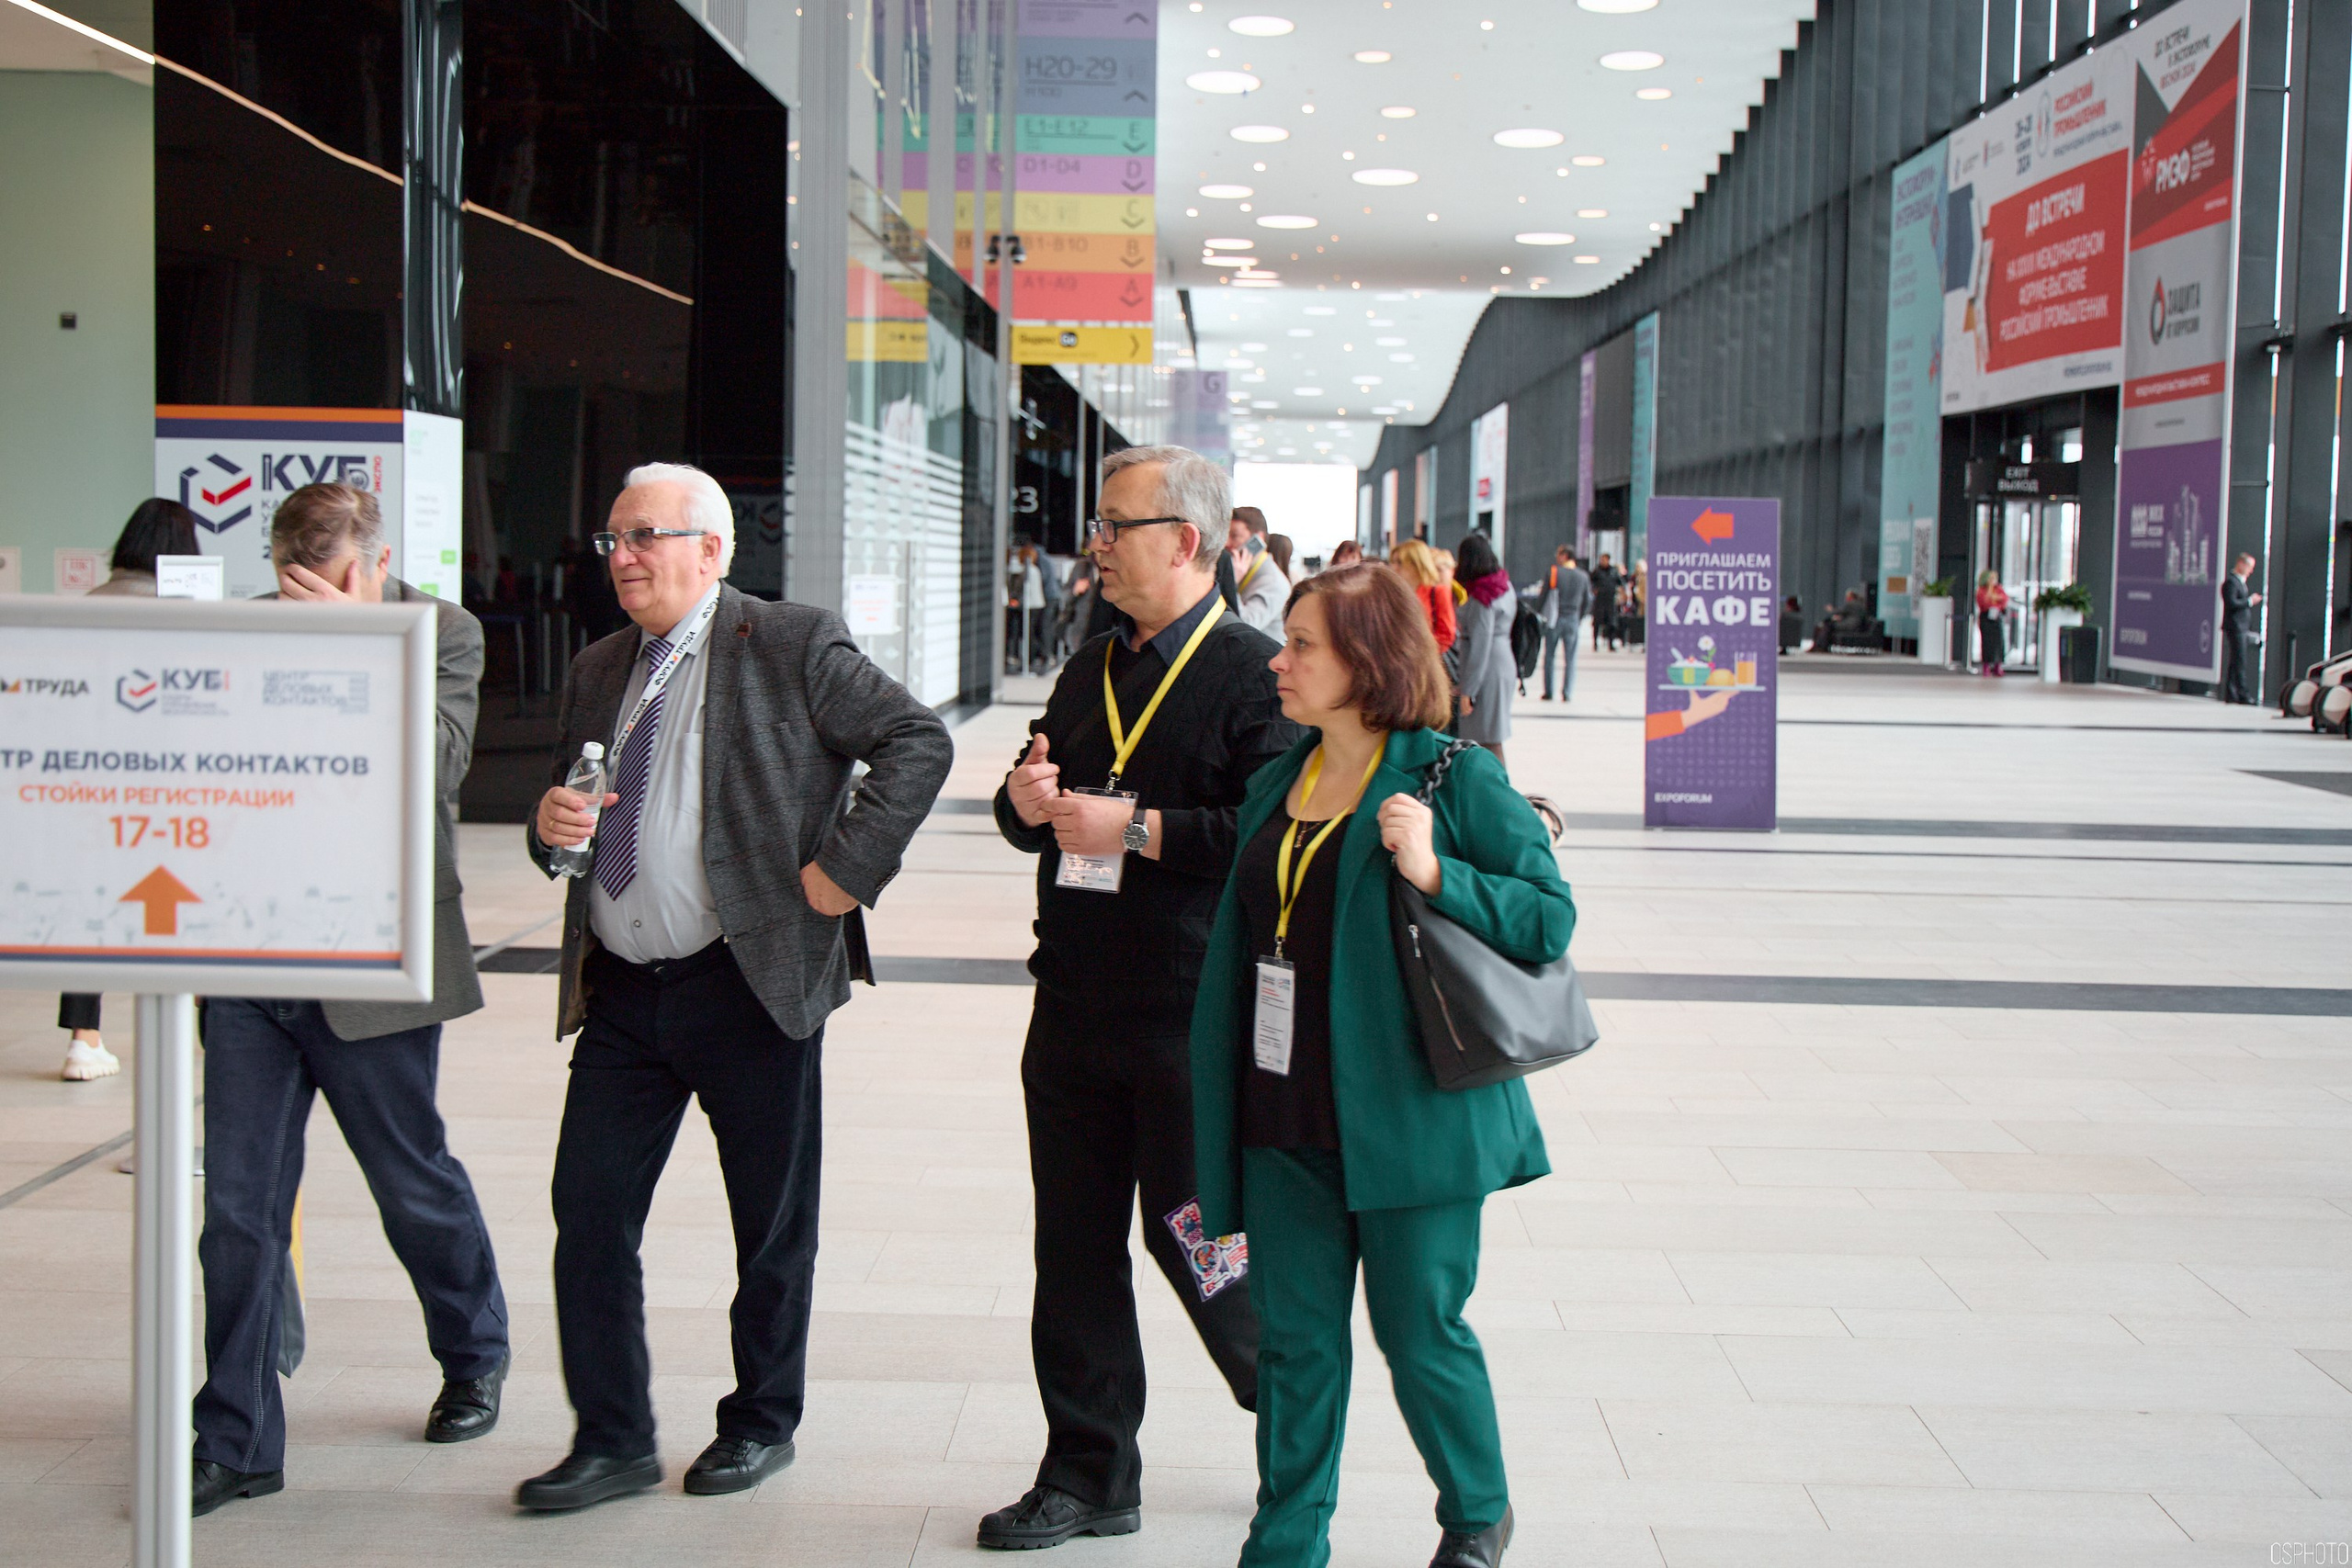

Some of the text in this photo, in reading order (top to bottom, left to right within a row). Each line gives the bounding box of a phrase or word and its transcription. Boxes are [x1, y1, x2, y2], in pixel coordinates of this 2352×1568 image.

[1024, 55, 1117, 79] H20-29
[1023, 158, 1142, 179] D1-D4 D
[1126, 198, 1139, 218] C
[1126, 239, 1139, 257] B
[1657, 552, 1770, 568] ПРИГЛАШАЕМ
[1657, 570, 1771, 591] ПОСЕТИТЬ
[1656, 595, 1770, 626] КАФЕ
[676, 631, 695, 654] ТРУДА
[26, 679, 90, 696] ТРУДА
[163, 670, 222, 690] КУБ
[42, 750, 187, 773] ДЕЛОВЫХ
[197, 754, 369, 776] КОНТАКТОВ
[18, 781, 294, 808] СТОЙКИ РЕГИСТРАЦИИ
[109, 815, 210, 850] 17-18
